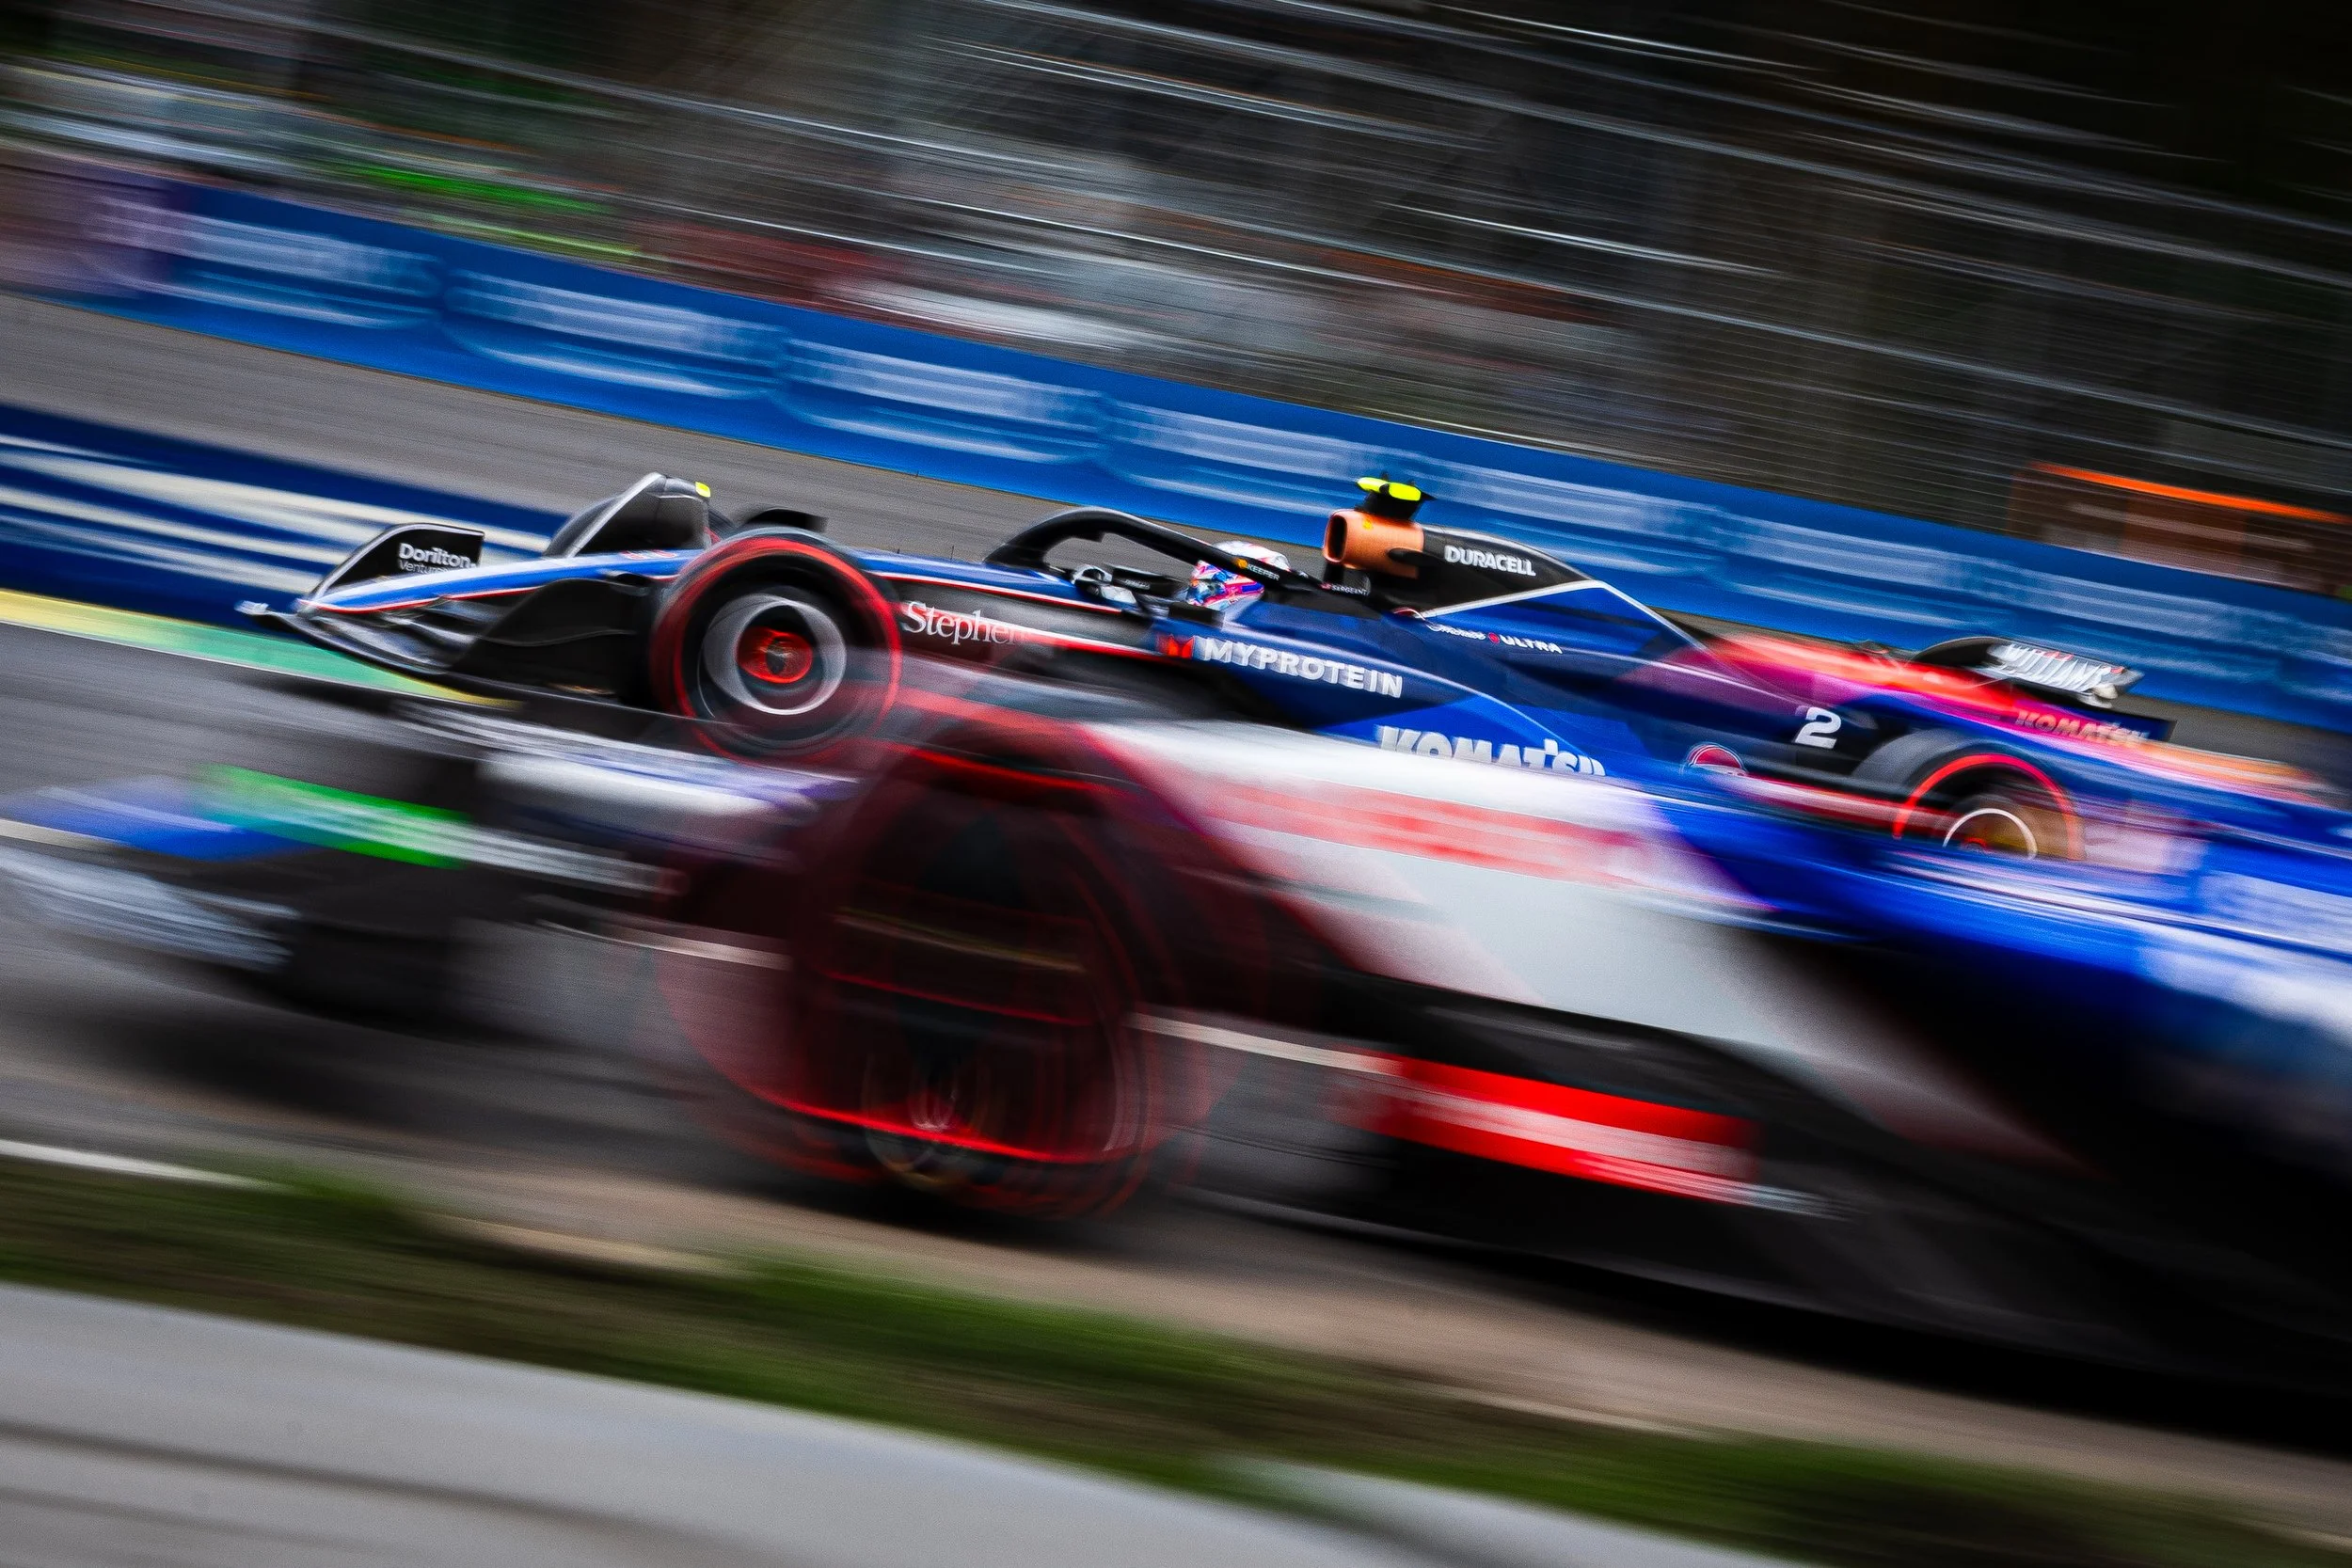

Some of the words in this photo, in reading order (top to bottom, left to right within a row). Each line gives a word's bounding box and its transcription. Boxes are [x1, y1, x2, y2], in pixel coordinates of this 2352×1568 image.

[1444, 545, 1536, 577] DURACELL
[1499, 633, 1563, 655] ULTRA
[1201, 637, 1403, 699] MYPROTEIN
[1794, 706, 1842, 750] 2
